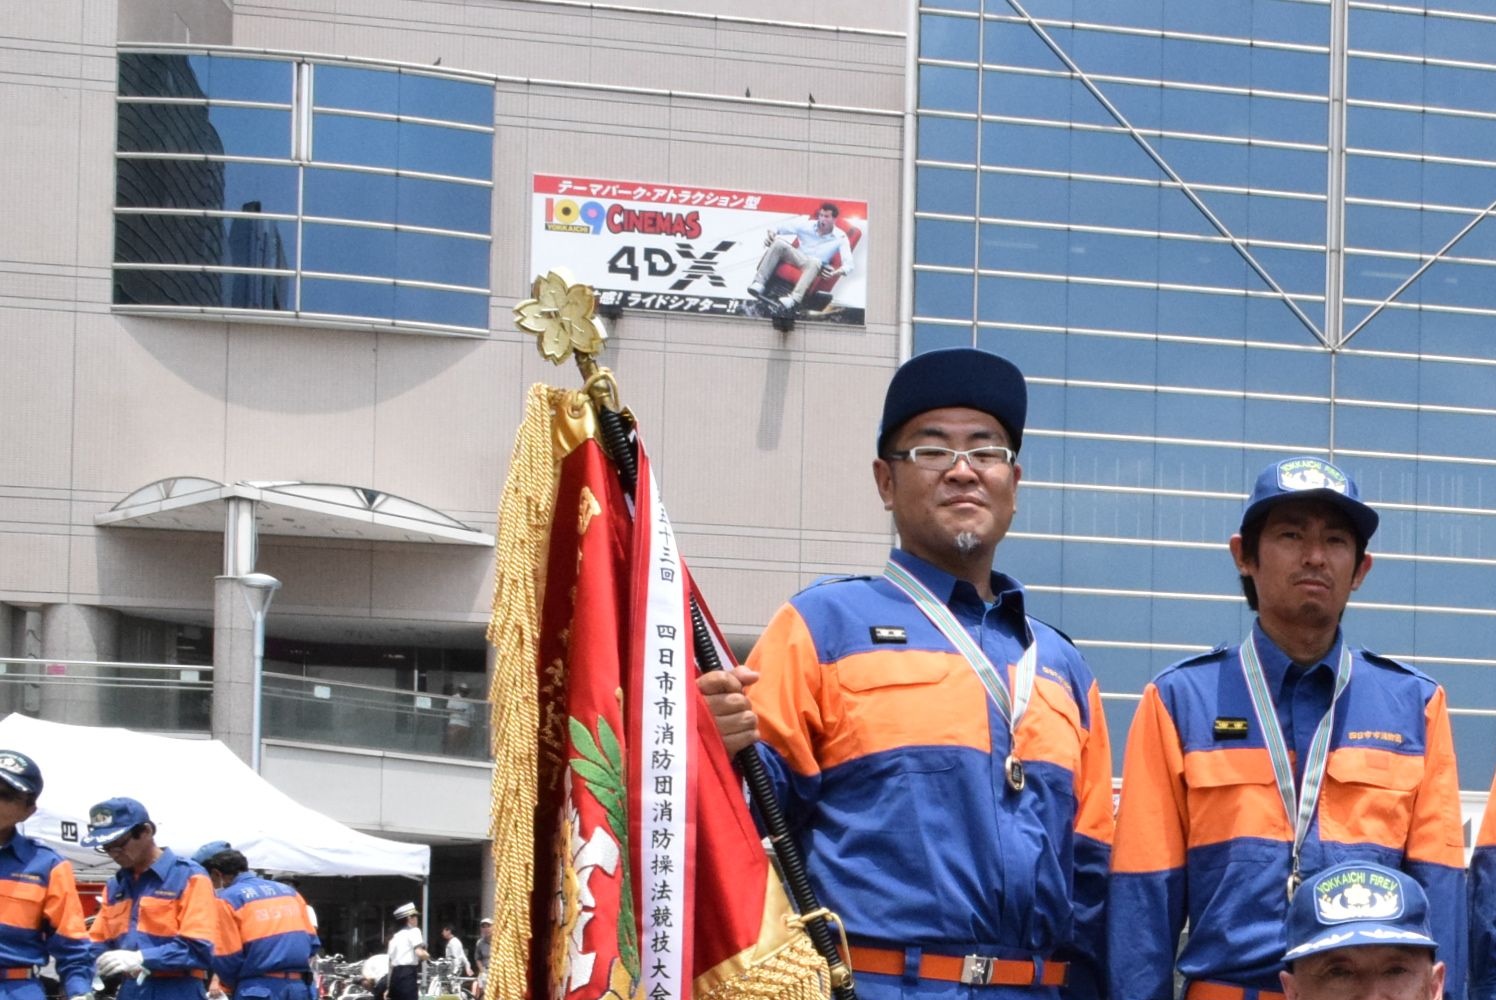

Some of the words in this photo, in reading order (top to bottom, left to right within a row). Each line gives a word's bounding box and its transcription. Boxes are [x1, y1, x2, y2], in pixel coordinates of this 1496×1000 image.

[545, 198, 606, 235] 109
[606, 203, 702, 240] CINEMAS
[608, 240, 737, 291] 4DX
[658, 495, 675, 583] 五十三回
[1317, 872, 1366, 893] YOKKAICHI
